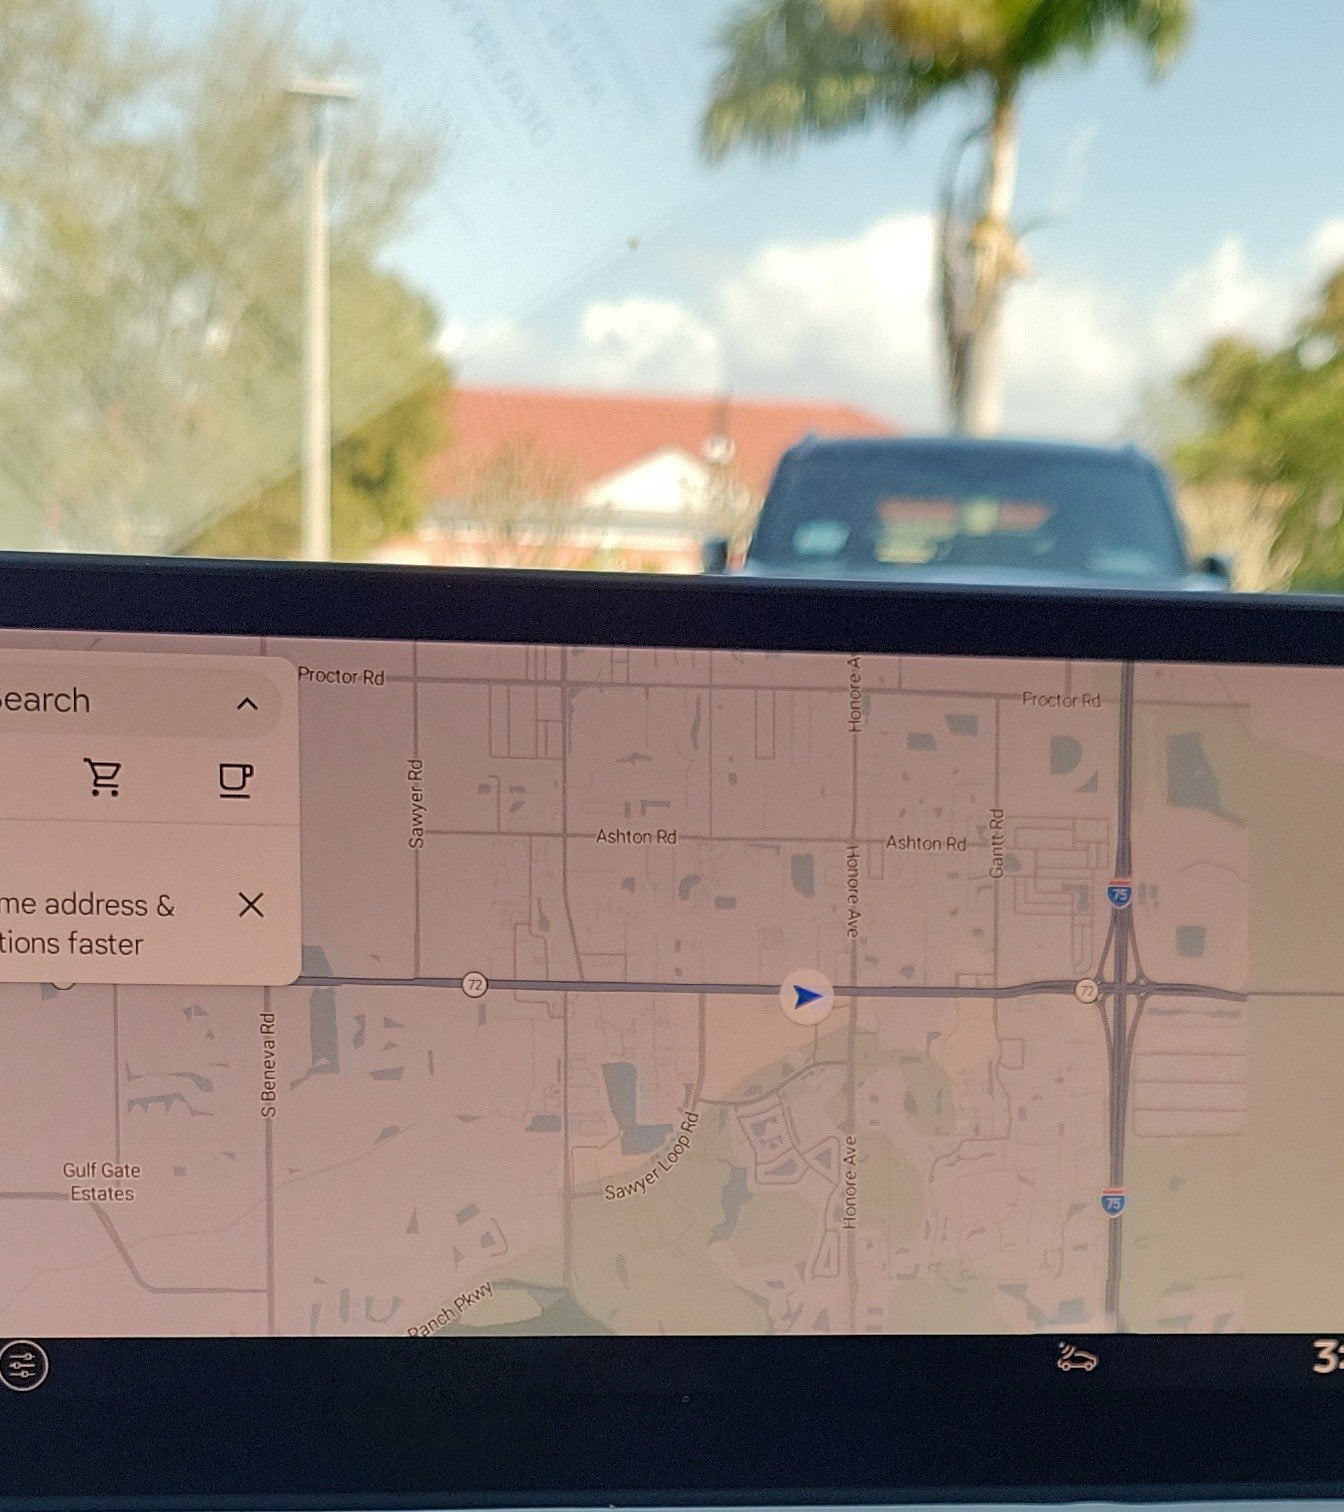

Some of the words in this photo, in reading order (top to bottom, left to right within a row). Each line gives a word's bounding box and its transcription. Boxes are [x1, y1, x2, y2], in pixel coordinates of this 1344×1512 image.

[297, 665, 356, 685] Proctor
[361, 668, 385, 686] Rd
[847, 672, 862, 732] Honore
[1022, 691, 1066, 708] Proctor
[1070, 692, 1101, 708] Rd
[408, 758, 423, 783] Rd
[408, 786, 426, 849] Sawyer
[989, 808, 1004, 826] Rd
[596, 829, 651, 846] Ashton
[655, 829, 677, 846] Rd
[886, 835, 942, 853] Ashton
[946, 836, 967, 853] Rd
[989, 829, 1006, 879] Gantt
[847, 845, 862, 902] Honore
[45, 889, 147, 918] address
[156, 893, 175, 917] &
[1112, 887, 1129, 903] 75
[847, 908, 861, 938] Ave
[68, 930, 144, 957] faster
[467, 977, 483, 992] 72
[1079, 982, 1095, 998] 72
[260, 1012, 275, 1035] Rd
[261, 1039, 275, 1101] Beneva
[261, 1106, 275, 1117] S
[605, 1168, 659, 1200] Sawyer
[657, 1135, 690, 1171] Loop
[680, 1111, 698, 1133] Rd
[843, 1135, 857, 1169] Ave
[63, 1161, 97, 1179] Gulf
[101, 1161, 140, 1179] Gate
[71, 1185, 134, 1202] Estates
[843, 1176, 857, 1229] Honore
[1104, 1197, 1121, 1211] 75
[407, 1308, 456, 1338] Ranch
[454, 1281, 493, 1313] Pkwy
